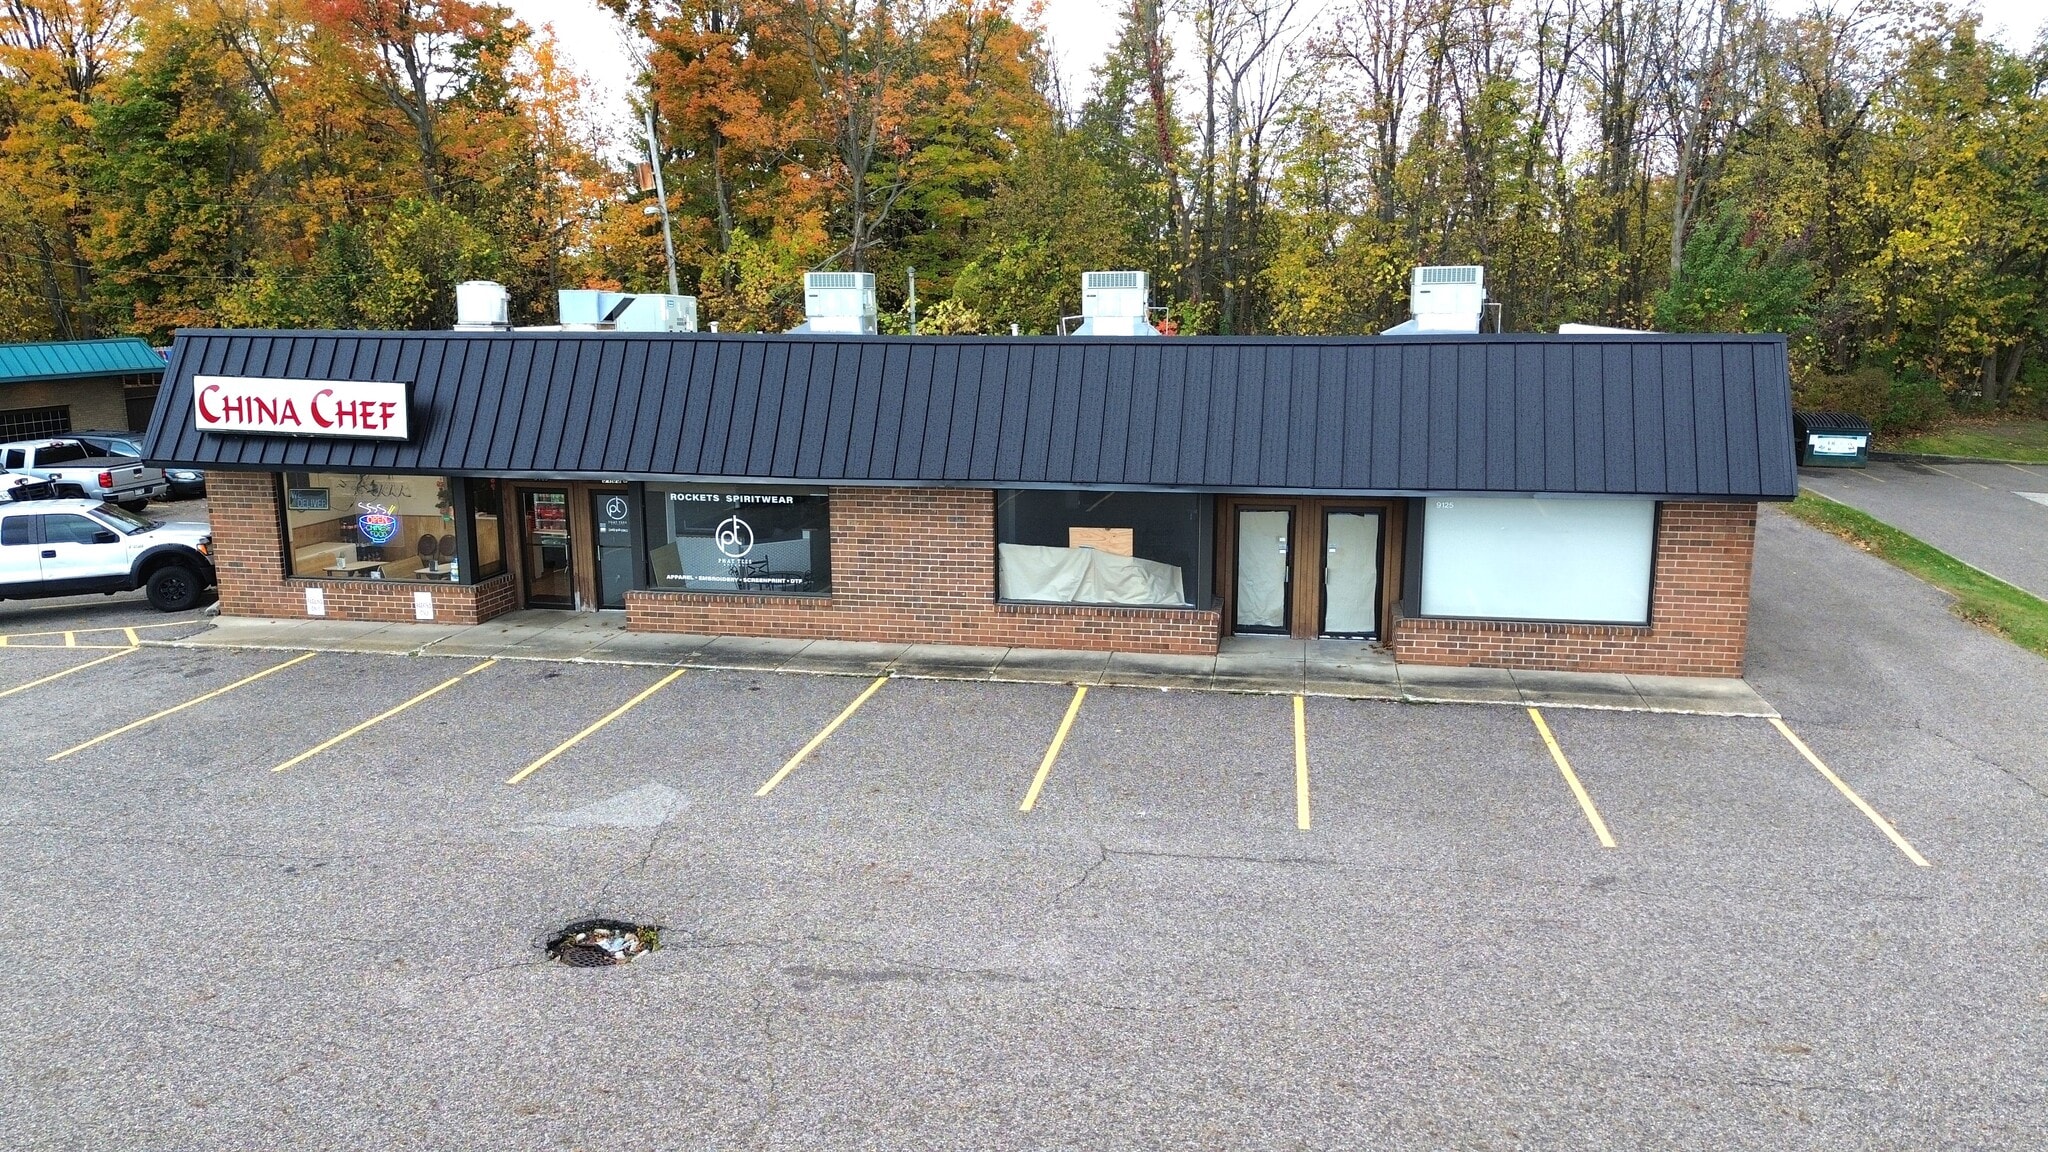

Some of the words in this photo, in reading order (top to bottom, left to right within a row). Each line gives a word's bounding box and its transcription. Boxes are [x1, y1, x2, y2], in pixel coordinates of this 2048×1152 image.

[198, 384, 302, 426] CHINA
[310, 388, 397, 430] CHEF
[297, 498, 327, 508] DELIVER
[670, 493, 720, 502] ROCKETS
[725, 494, 794, 504] SPIRITWEAR
[1436, 501, 1454, 509] 9125
[367, 516, 389, 524] OPEN
